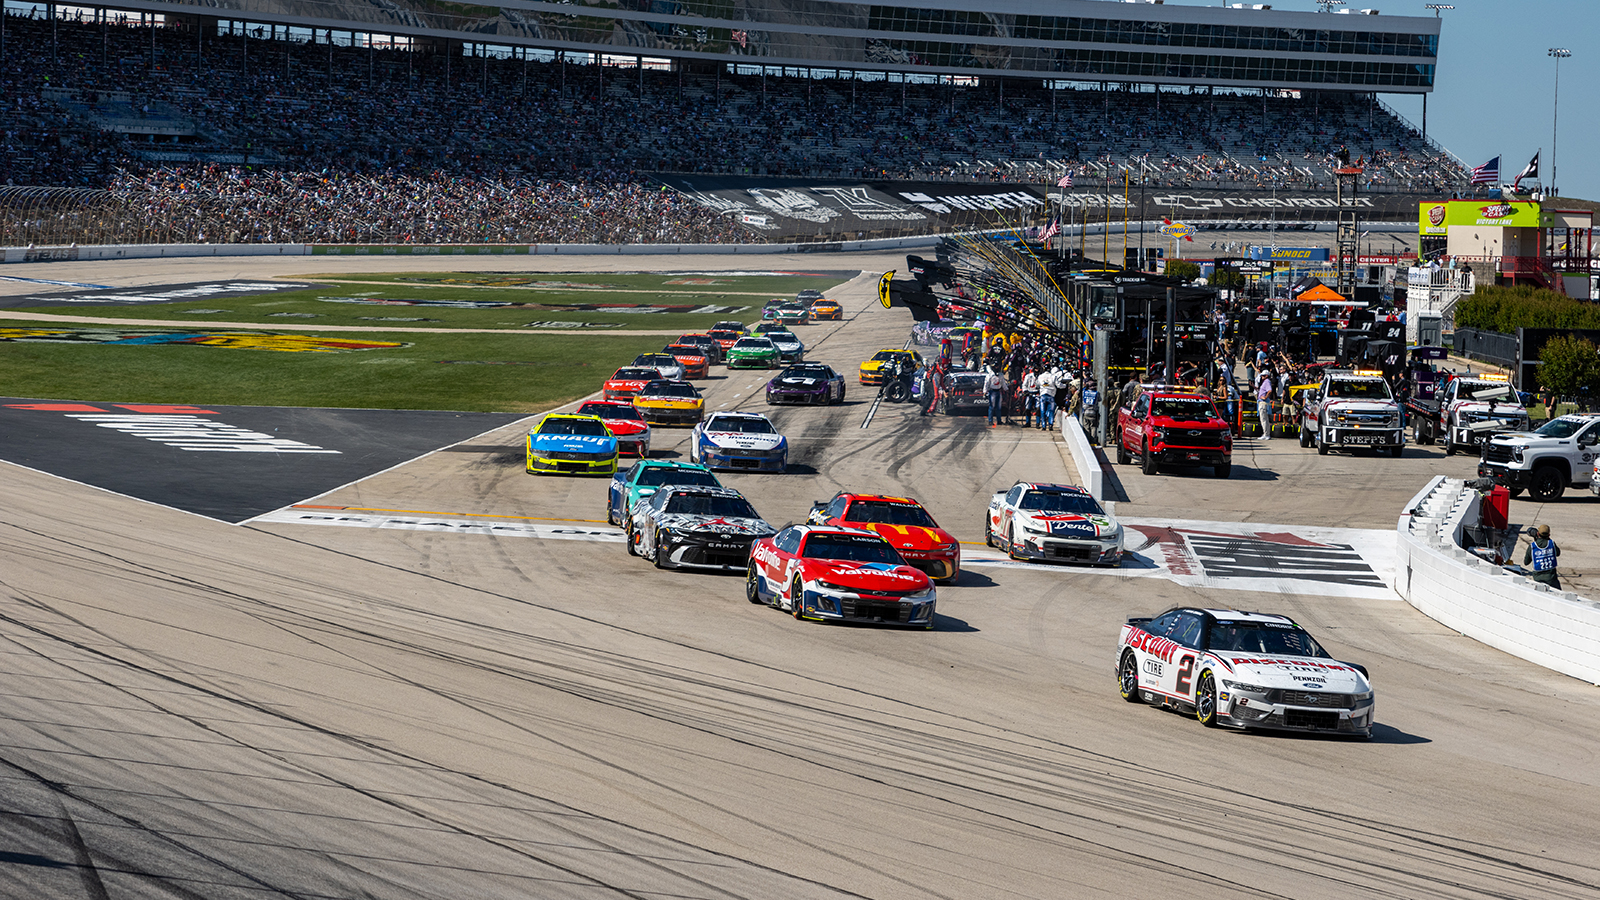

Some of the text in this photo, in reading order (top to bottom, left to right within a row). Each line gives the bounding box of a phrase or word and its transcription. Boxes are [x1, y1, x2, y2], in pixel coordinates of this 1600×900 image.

[1163, 227, 1194, 235] SUNOCO
[1271, 250, 1311, 258] SUNOCO
[1387, 327, 1400, 337] 24
[1328, 429, 1337, 442] 1
[1343, 435, 1386, 444] STEPP'S
[1392, 431, 1400, 443] 1
[1460, 429, 1468, 442] 1
[1054, 521, 1094, 532] Dente
[831, 568, 915, 582] Valvoline
[1125, 626, 1179, 665] DISCOUNT
[1147, 661, 1162, 675] TIRE
[1231, 657, 1355, 673] DISCOUNT
[1176, 653, 1195, 696] 2
[1293, 675, 1327, 683] PENNZOIL
